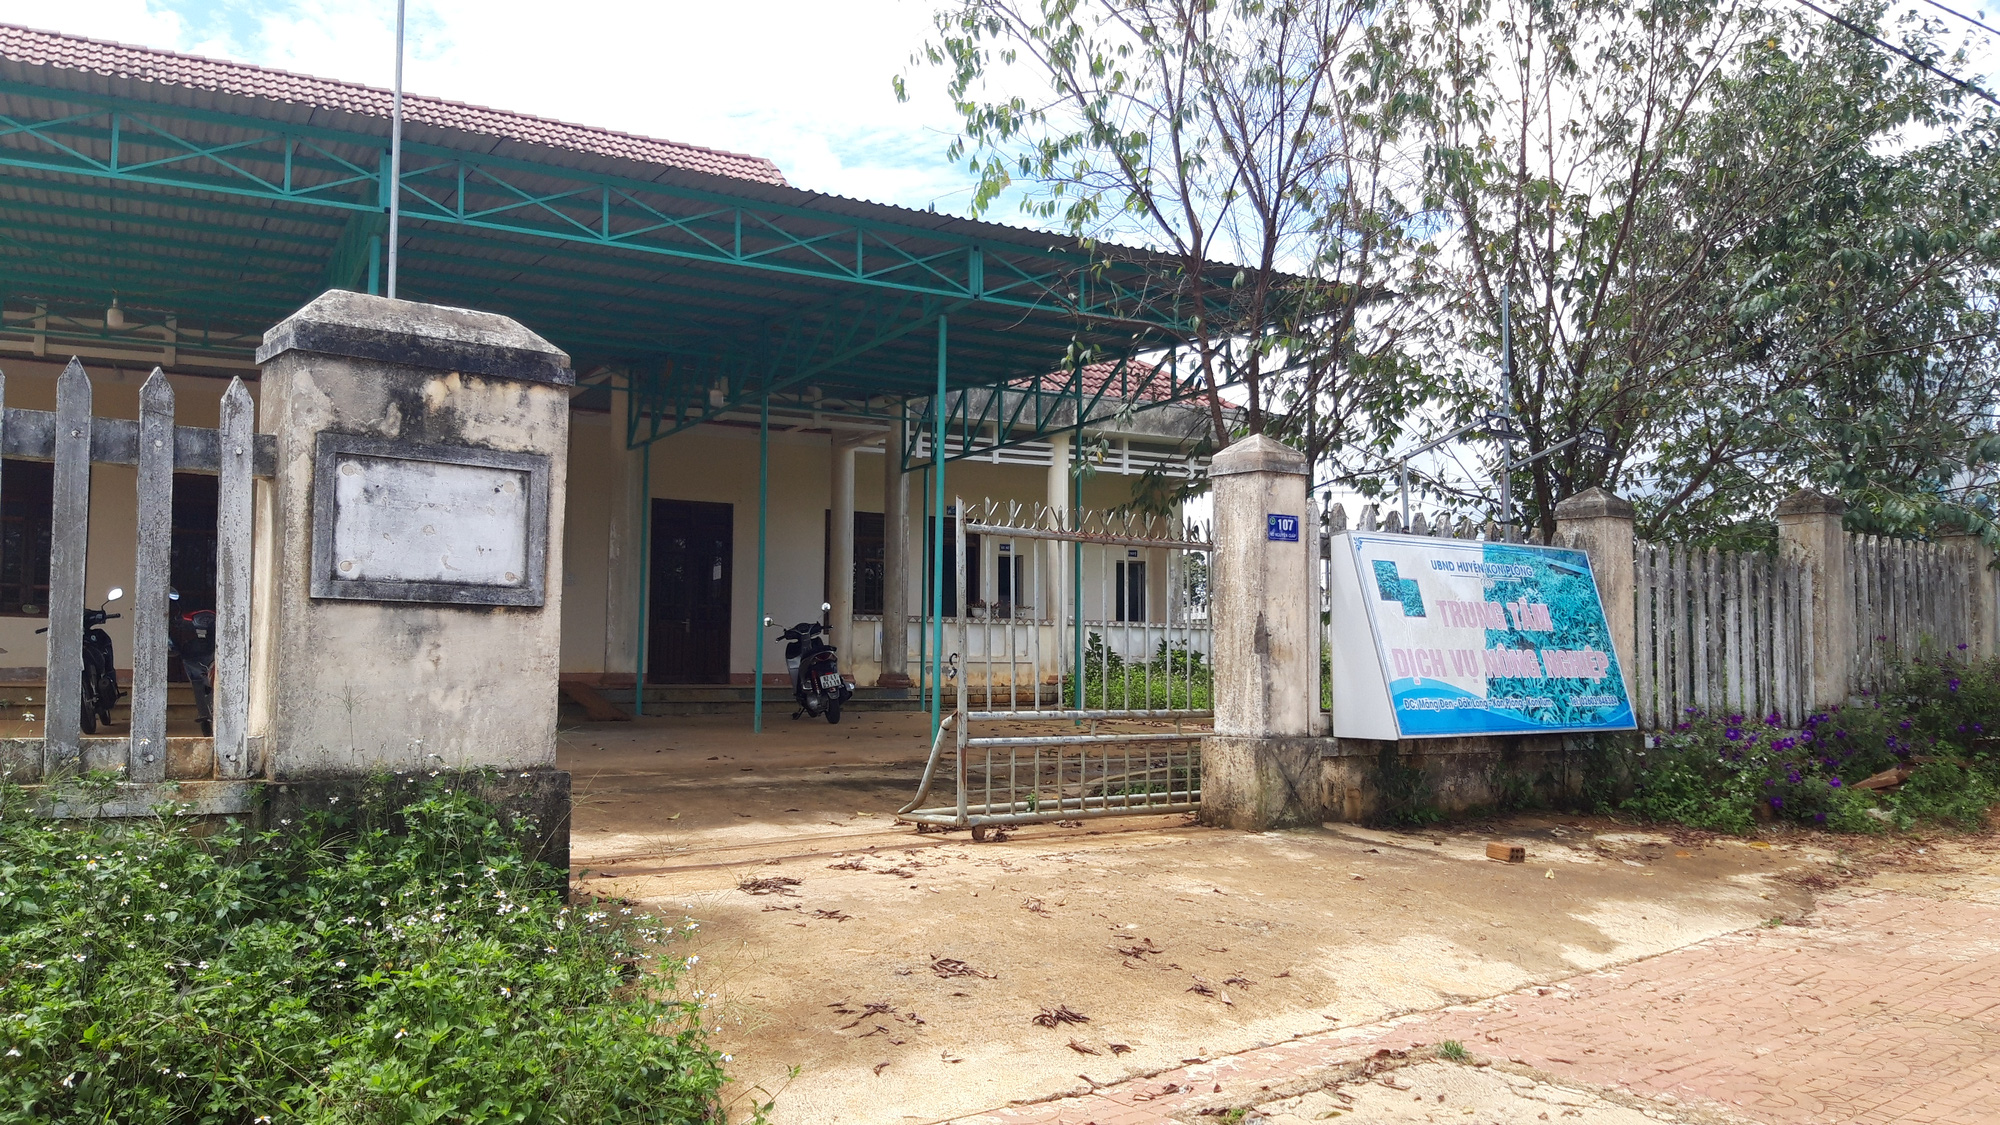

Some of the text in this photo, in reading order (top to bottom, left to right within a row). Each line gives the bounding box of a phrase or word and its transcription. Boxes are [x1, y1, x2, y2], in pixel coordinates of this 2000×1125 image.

[1278, 519, 1294, 531] 107
[1430, 559, 1455, 572] UBND
[1457, 560, 1484, 576] HUYỆN
[1485, 563, 1504, 575] KON
[1435, 597, 1553, 631] TRUNG TÂM
[1391, 643, 1609, 685] DỊCH VỤ NÔNG NGHIỆP
[1439, 698, 1454, 709] Đen
[1473, 698, 1489, 710] Long
